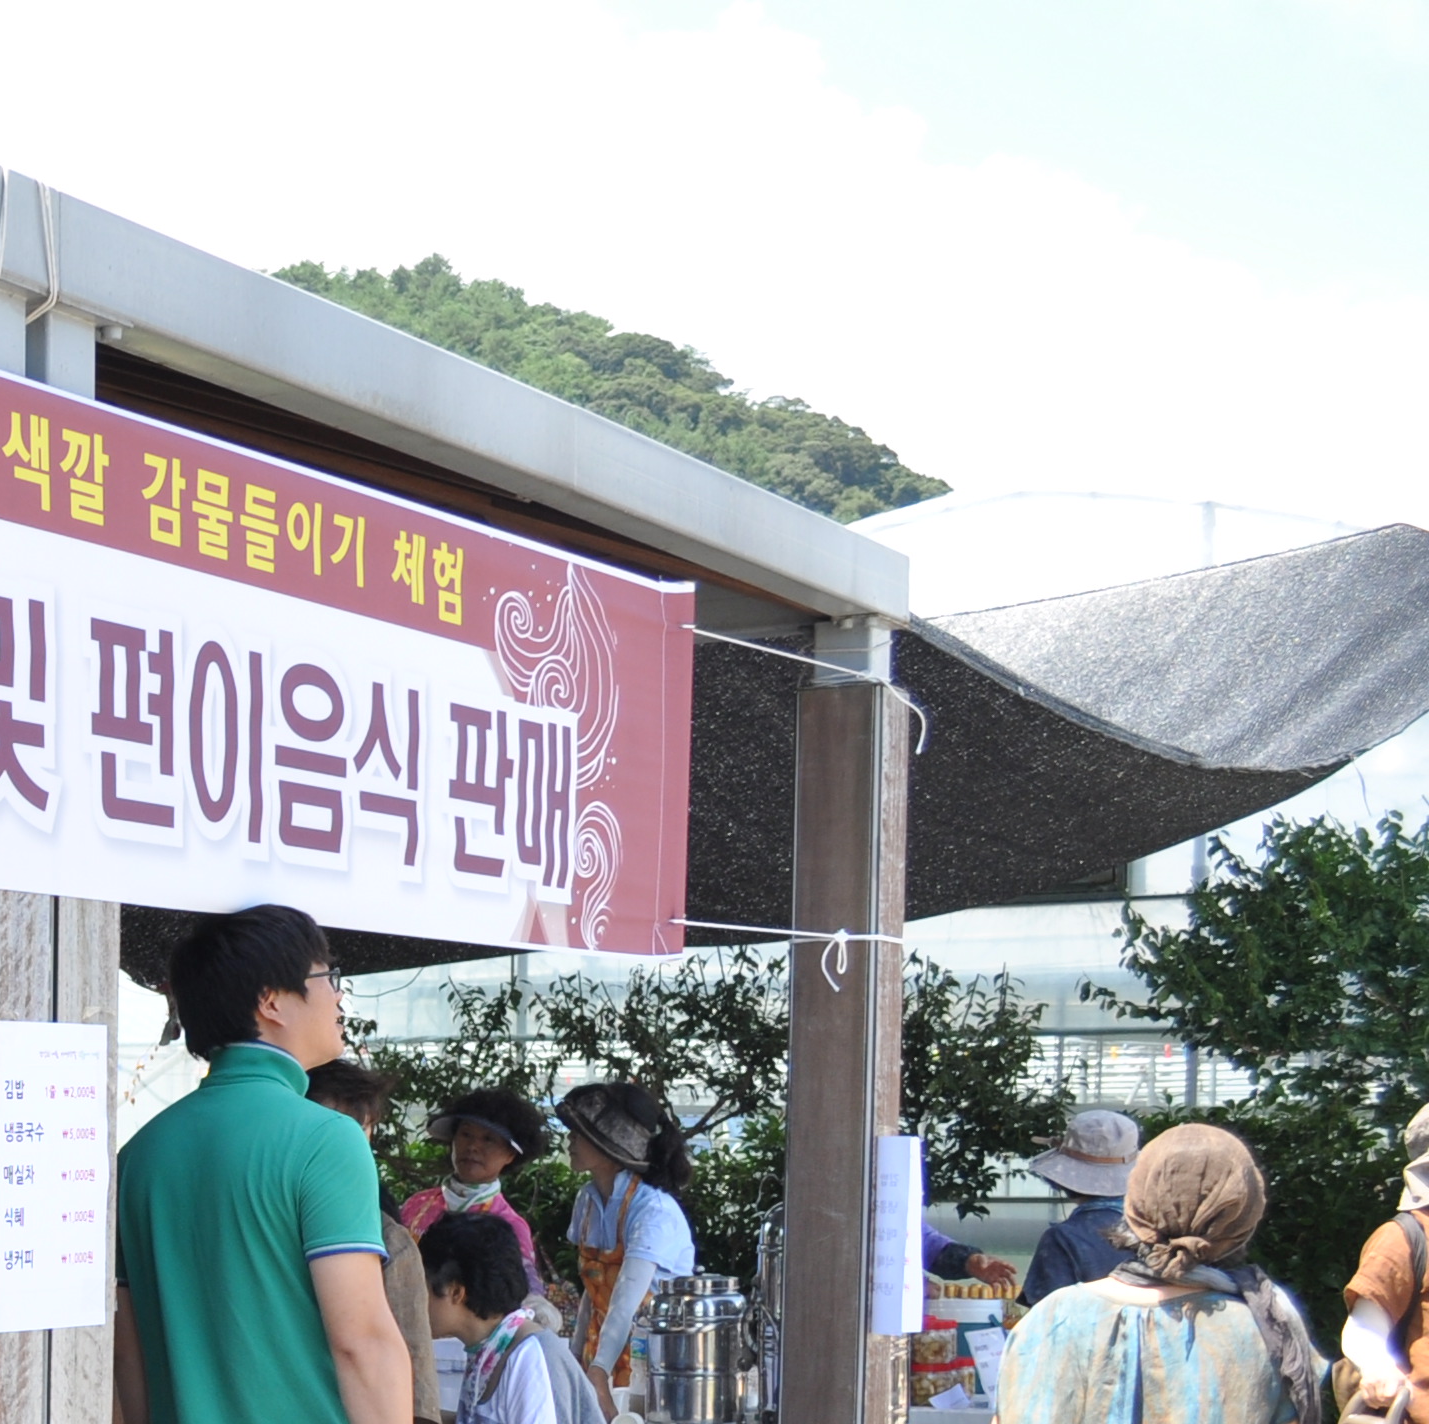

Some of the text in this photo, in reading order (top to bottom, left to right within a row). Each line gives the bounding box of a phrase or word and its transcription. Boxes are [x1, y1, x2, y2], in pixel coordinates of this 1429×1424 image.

[2, 408, 109, 528] 색깔
[140, 448, 367, 590] 감물들이기
[392, 530, 466, 627] 체험
[89, 614, 423, 869] 편이음식
[447, 700, 575, 890] 판매
[4, 1079, 26, 1100] 김밥
[4, 1121, 45, 1143] 냉콩국수
[3, 1164, 35, 1186] 매실차
[4, 1207, 25, 1228] 식혜
[4, 1249, 34, 1271] 냉커피
